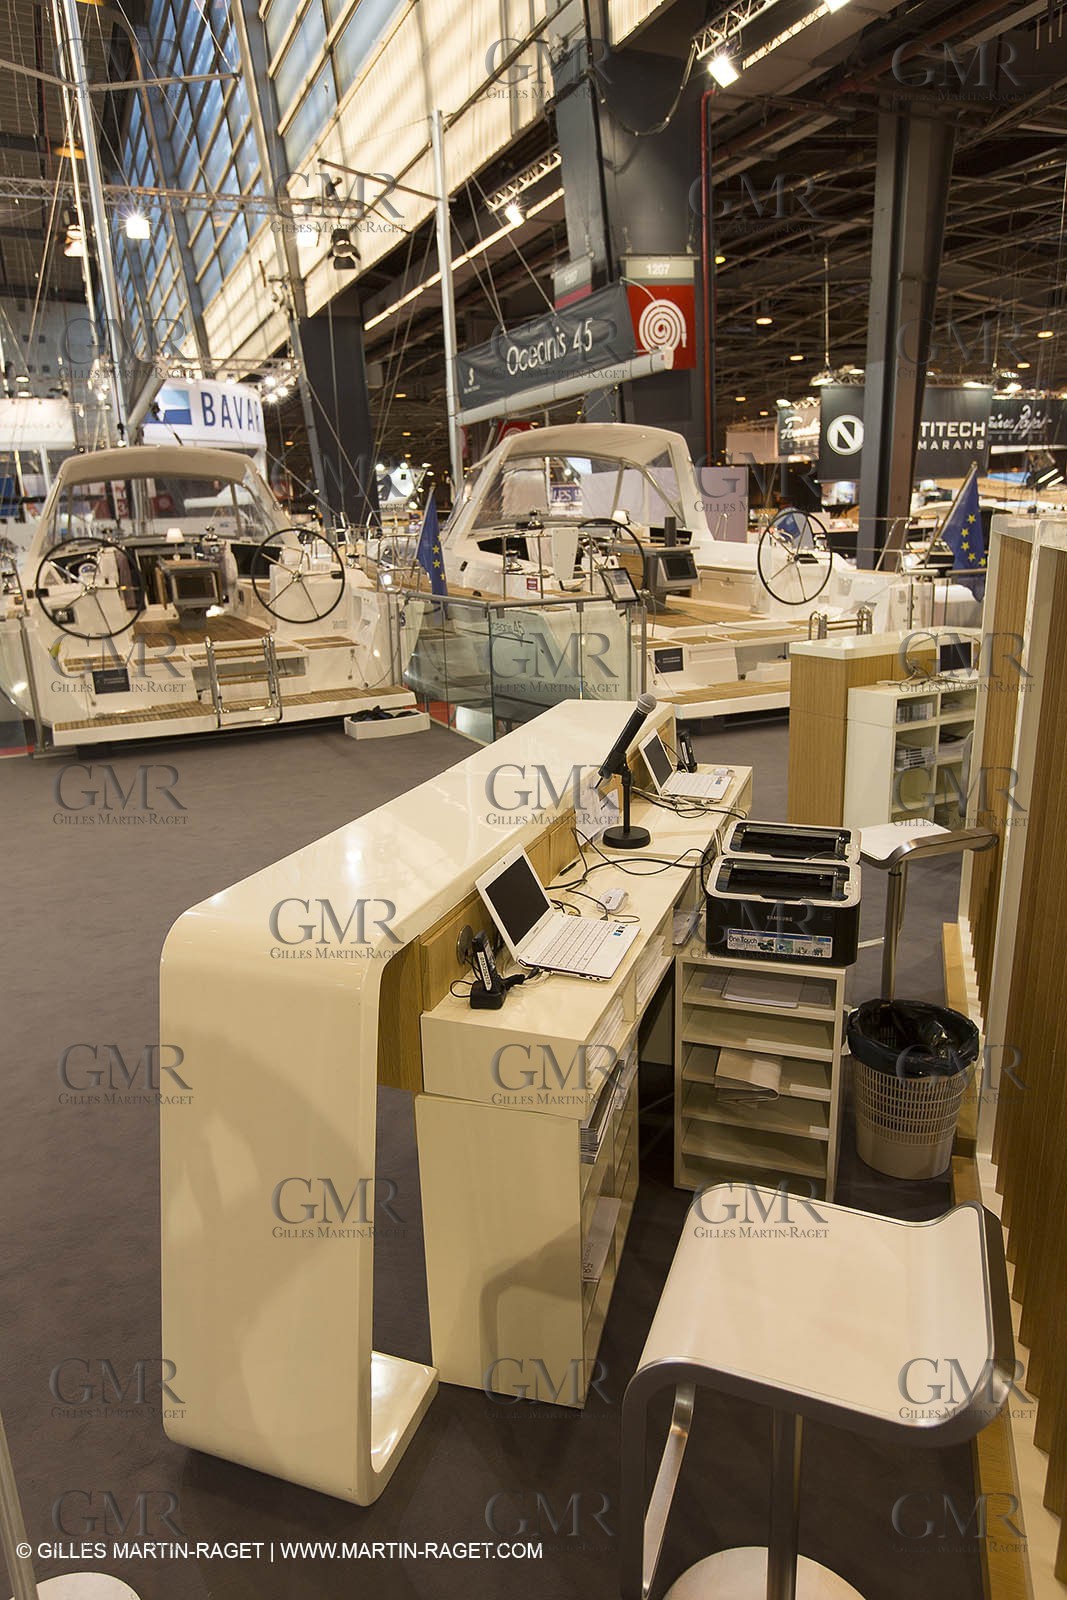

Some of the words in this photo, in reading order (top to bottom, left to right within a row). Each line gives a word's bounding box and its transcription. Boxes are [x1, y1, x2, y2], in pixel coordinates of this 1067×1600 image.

[507, 326, 567, 375] Oceanis
[574, 318, 593, 351] 45
[920, 421, 986, 438] TITECH
[918, 440, 985, 450] MARANS
